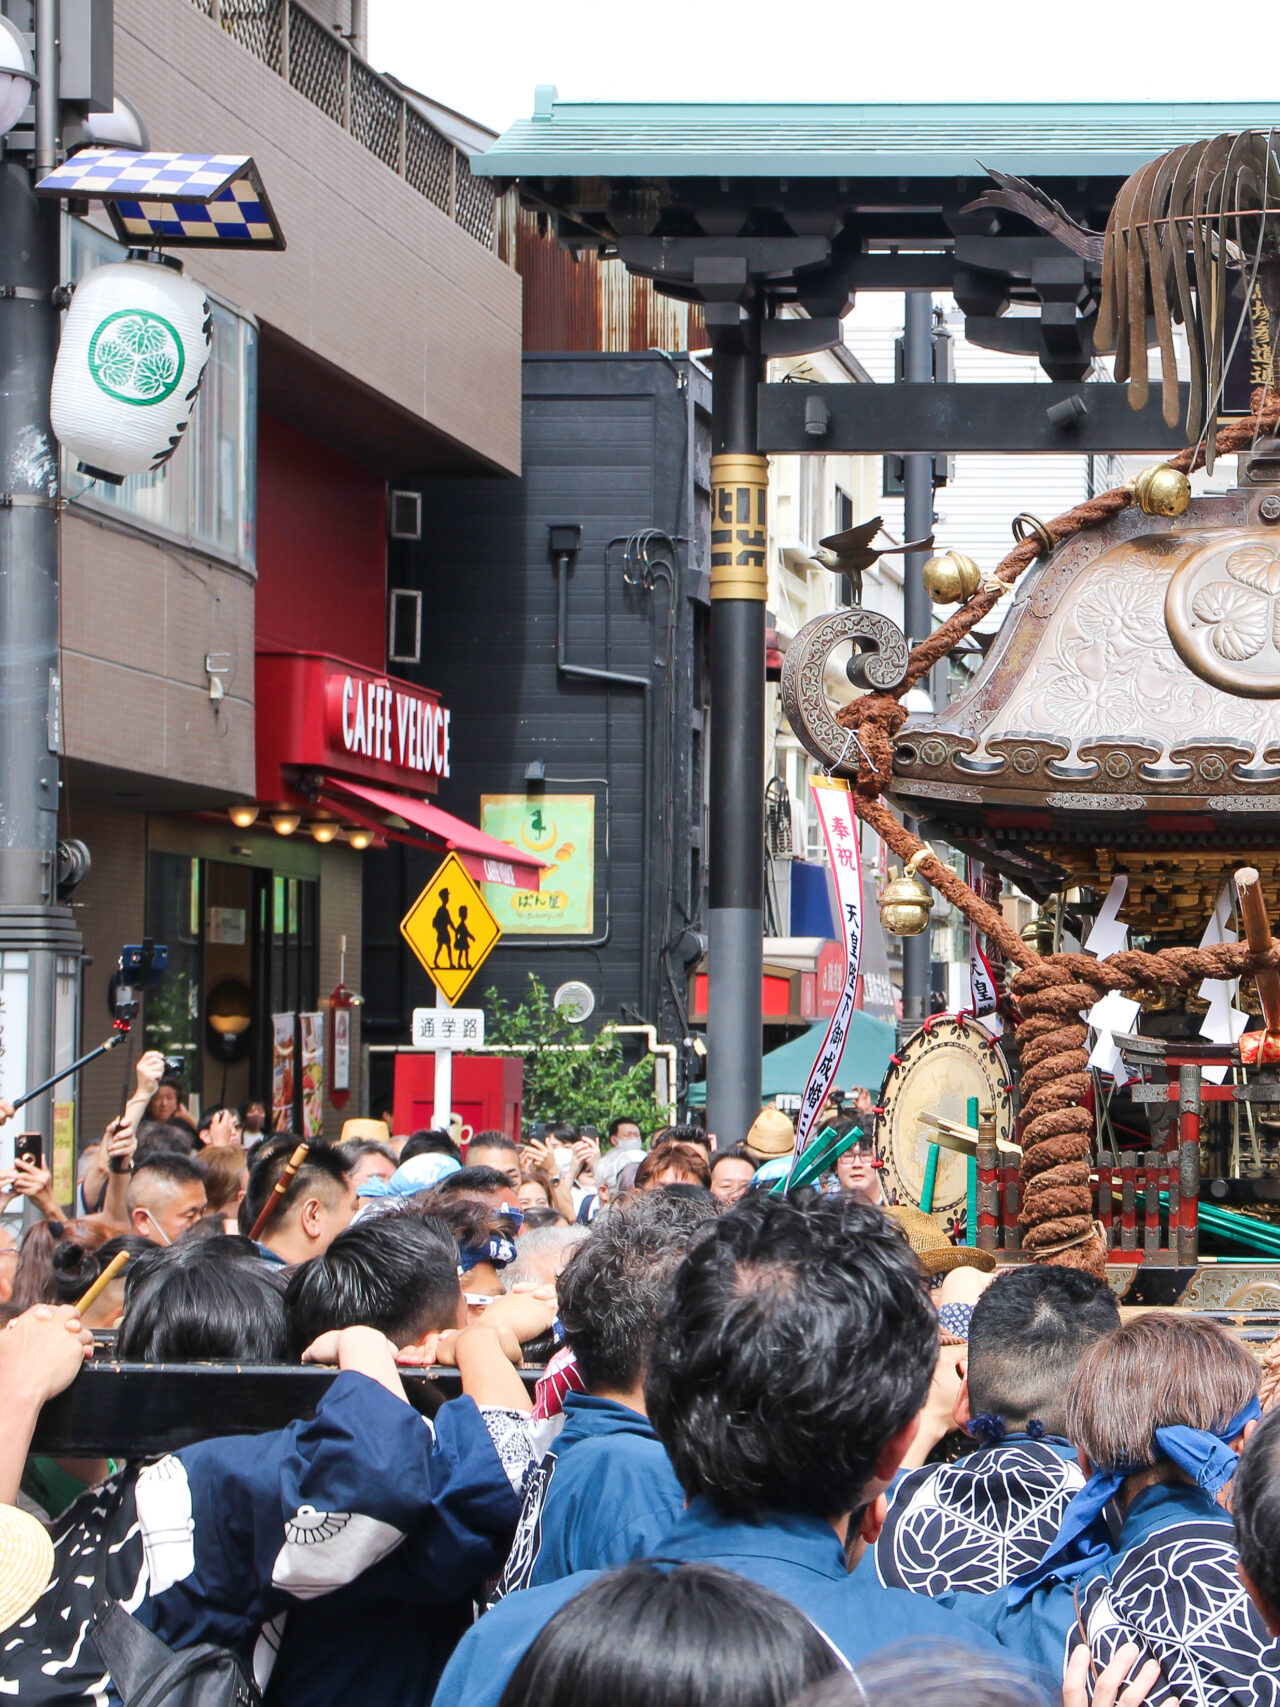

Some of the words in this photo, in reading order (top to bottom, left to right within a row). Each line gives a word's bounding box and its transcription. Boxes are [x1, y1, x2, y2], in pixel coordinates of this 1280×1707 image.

[396, 692, 450, 778] VELOCE
[831, 815, 857, 872] 奉祝
[420, 1017, 477, 1038] 通学路
